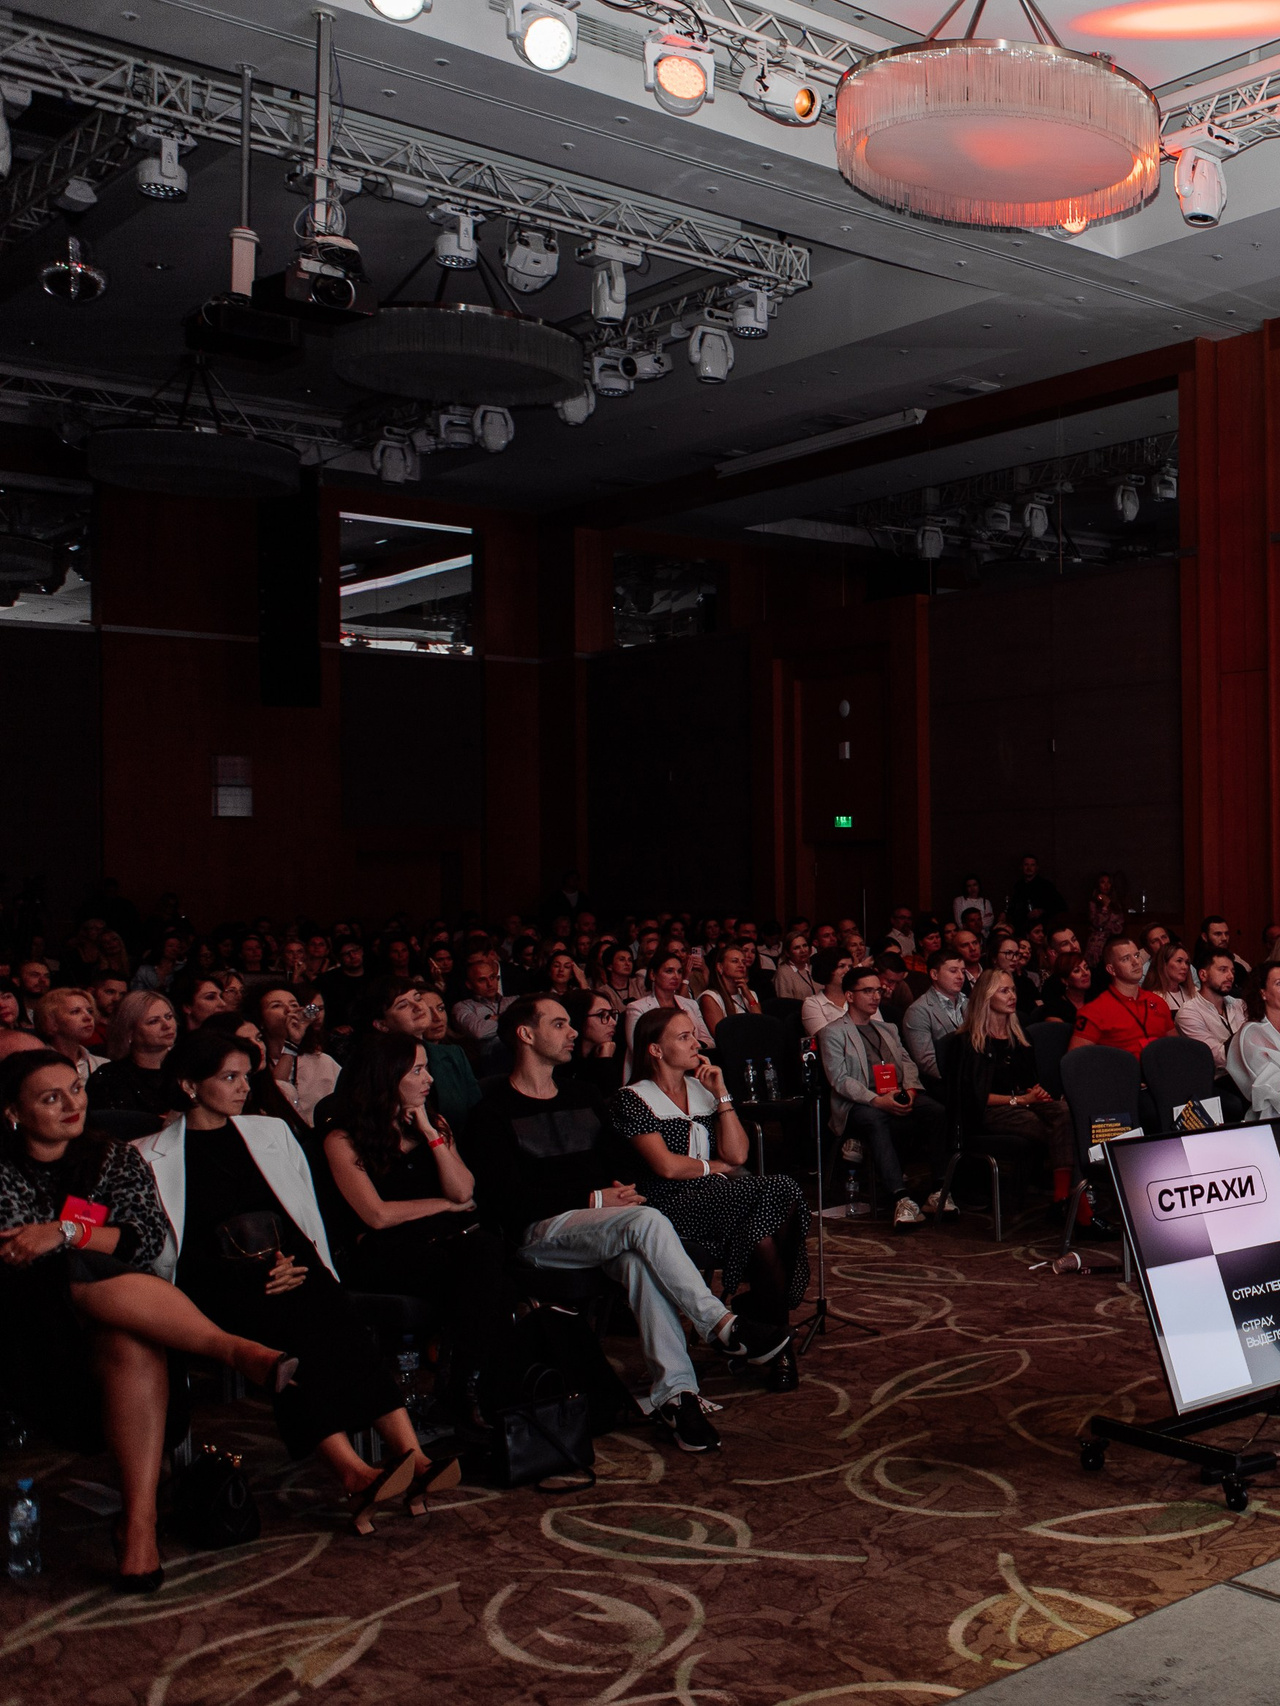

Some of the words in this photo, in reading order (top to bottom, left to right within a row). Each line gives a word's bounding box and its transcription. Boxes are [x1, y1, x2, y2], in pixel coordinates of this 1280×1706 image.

[1158, 1175, 1255, 1212] СТРАХИ
[1232, 1283, 1266, 1301] СТРАХ
[1241, 1314, 1275, 1332] СТРАХ
